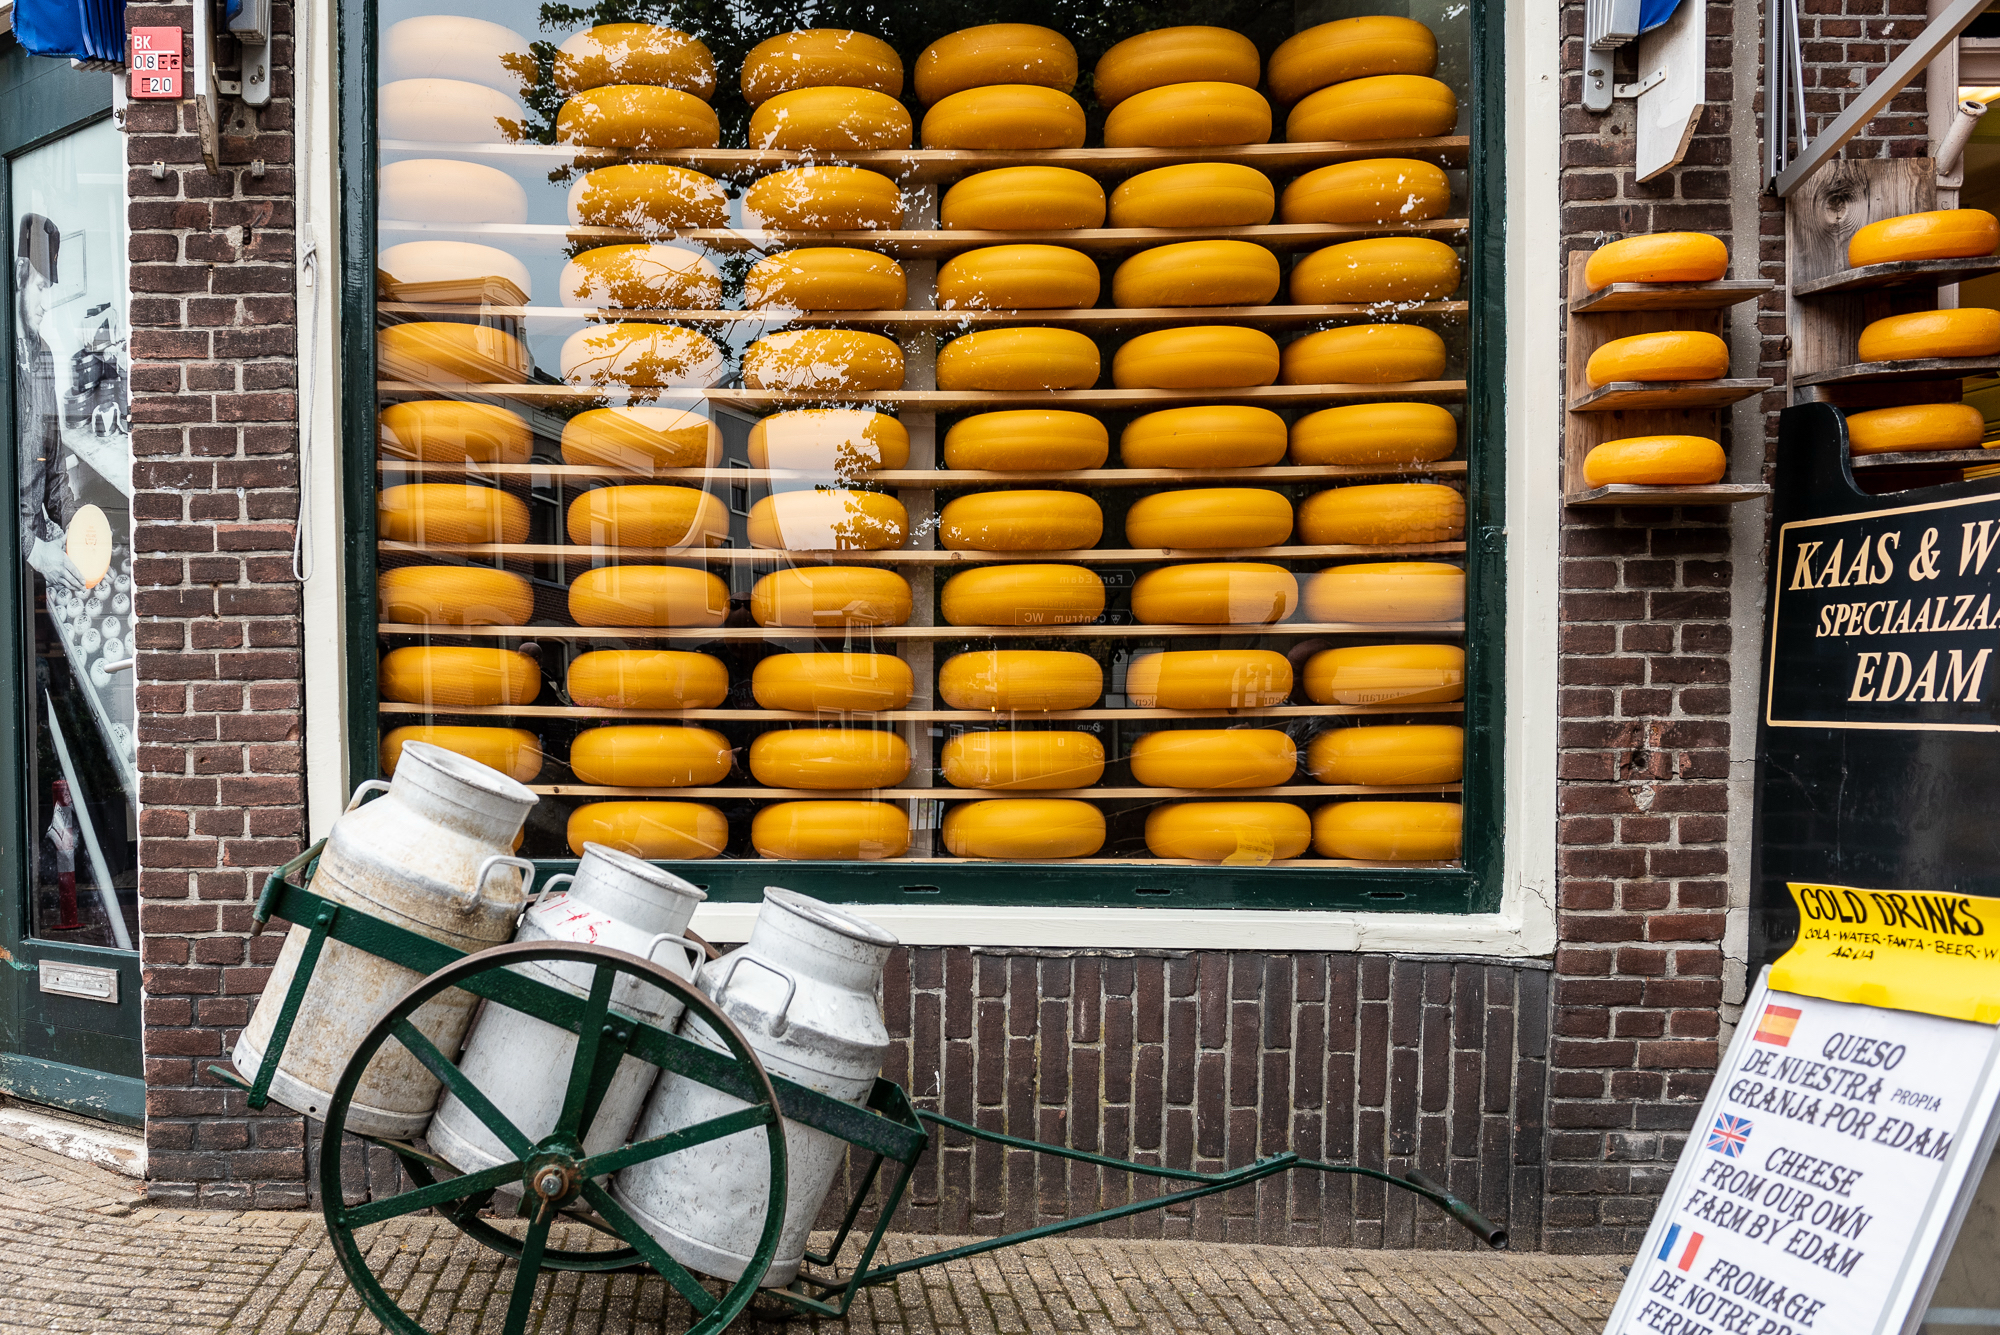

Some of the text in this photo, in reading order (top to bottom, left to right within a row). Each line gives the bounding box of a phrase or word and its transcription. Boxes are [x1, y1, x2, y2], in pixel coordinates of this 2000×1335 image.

[134, 36, 151, 49] BK
[1788, 531, 1901, 590] KAAS
[1909, 528, 1941, 581] &
[1847, 649, 1993, 702] EDAM
[1800, 888, 1984, 936] COLD DRINKS
[1828, 945, 1874, 961] AQUA
[1740, 1048, 1942, 1113] DE NUESTRA PROPIA
[1822, 1032, 1906, 1071] QUESO
[1728, 1078, 1956, 1162] GRANJA POR EDAM
[1699, 1159, 1873, 1241] FROM OUR OWN
[1765, 1146, 1863, 1198] CHEESE
[1682, 1188, 1864, 1278] FARM BY EDAM
[1649, 1269, 1686, 1300] DE
[1679, 1284, 1760, 1335] NOTRE
[1703, 1258, 1826, 1328] FROMAGE
